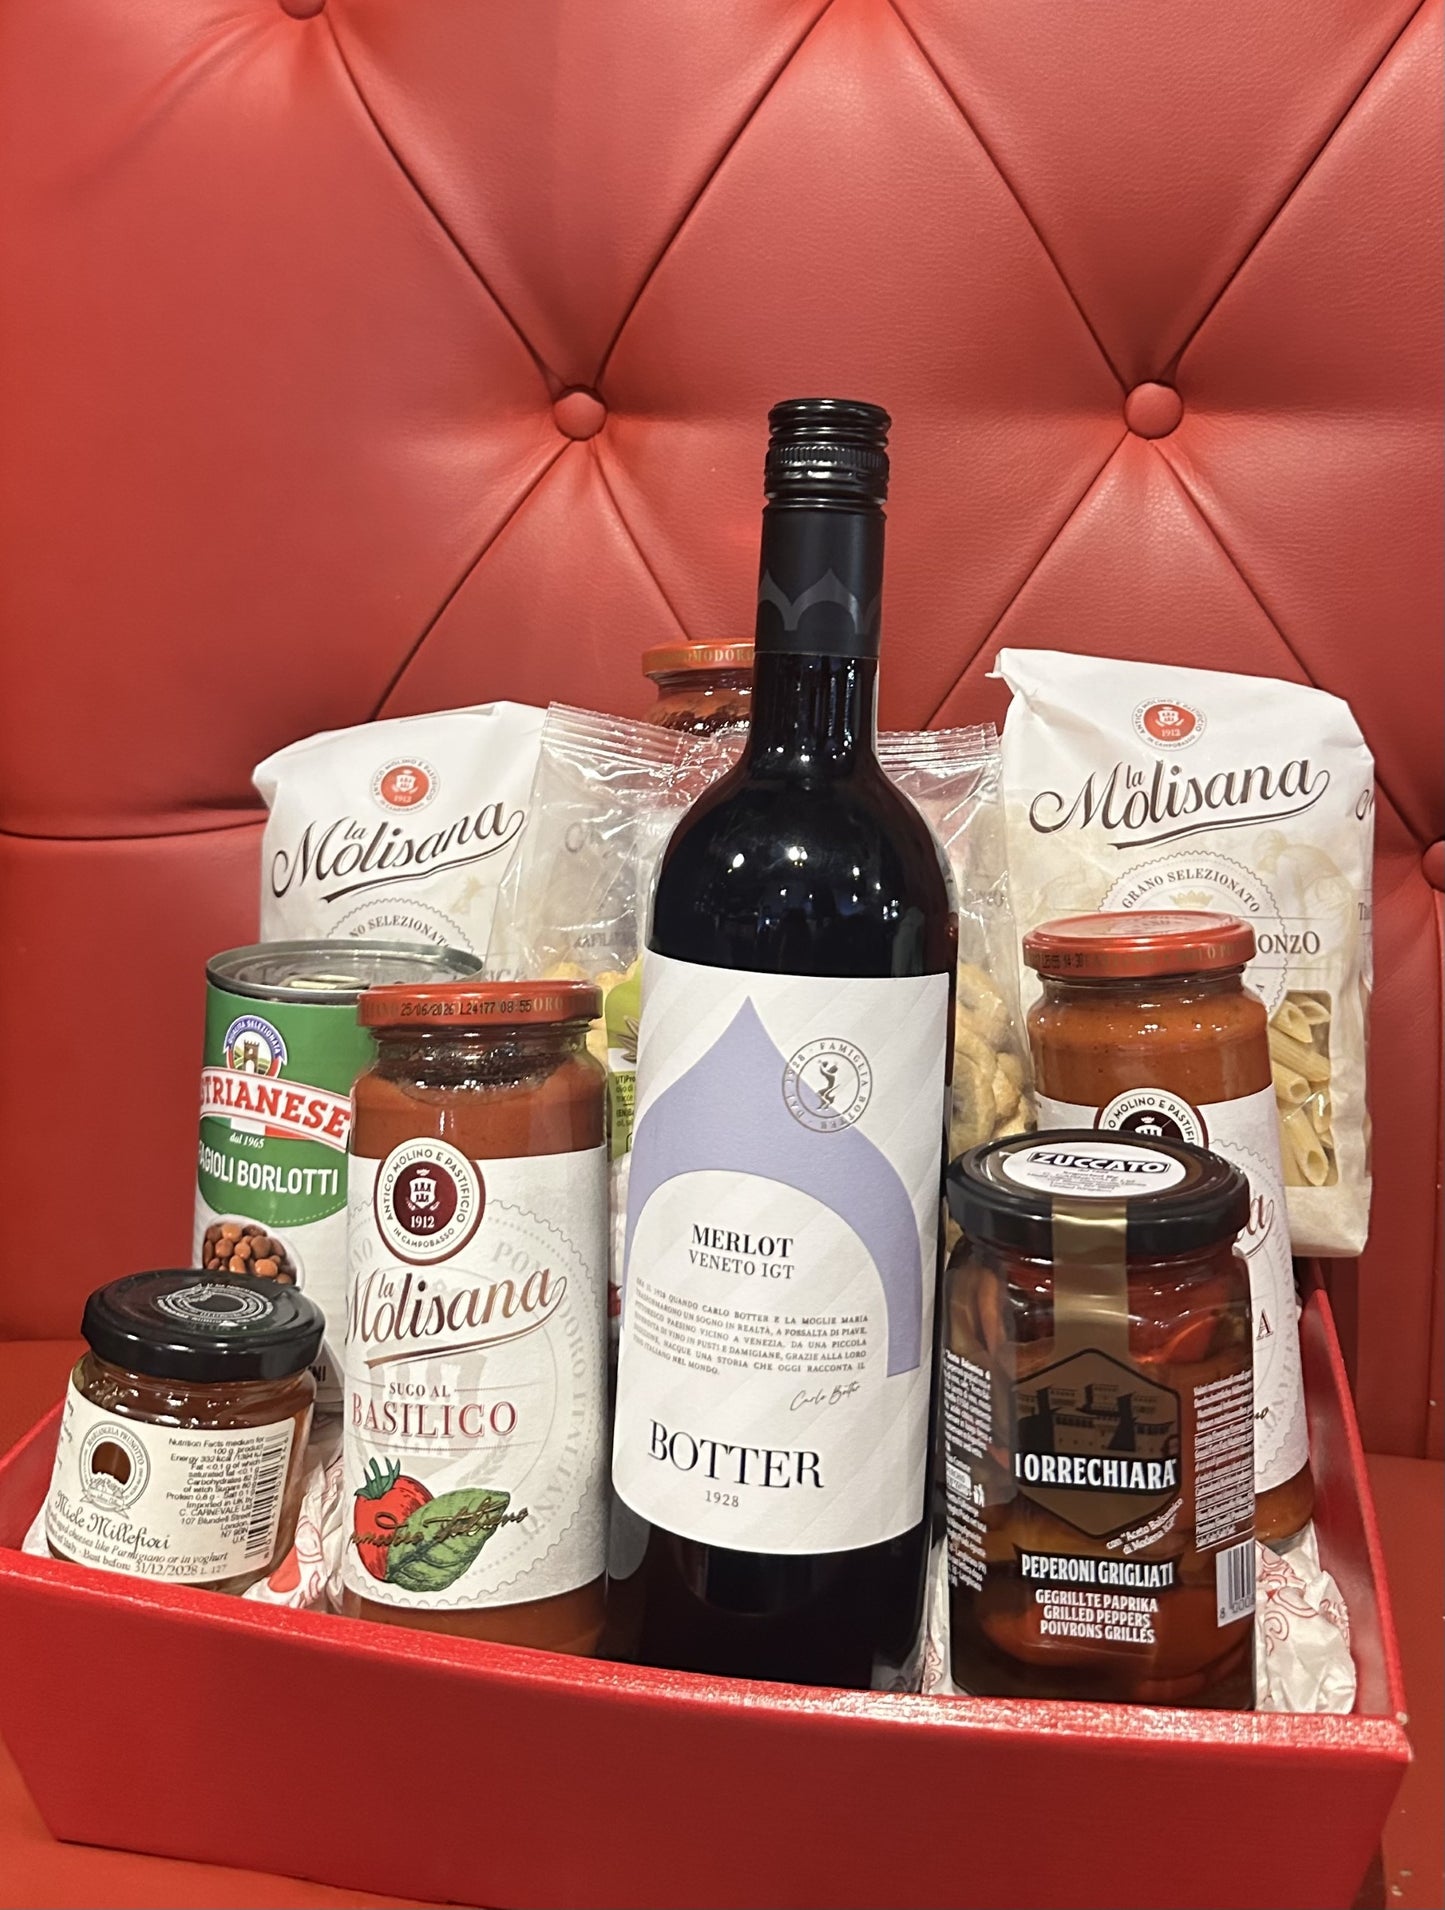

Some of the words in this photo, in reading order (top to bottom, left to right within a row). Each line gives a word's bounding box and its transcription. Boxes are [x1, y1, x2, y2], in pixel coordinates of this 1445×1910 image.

[1161, 728, 1181, 737] 1912
[1126, 764, 1144, 788] la
[1029, 758, 1331, 834] Molisana
[344, 820, 368, 841] la
[271, 801, 526, 898] Molisana
[1121, 876, 1164, 910] GRANO
[1167, 868, 1261, 914] SELEZIONATO
[1257, 930, 1321, 956] ONZO
[460, 1000, 495, 1016] L24177
[500, 999, 532, 1013] 08:55
[819, 1041, 869, 1087] FAMIGLIA
[1113, 1096, 1156, 1120] MOLINO
[1158, 1100, 1166, 1109] E
[1167, 1103, 1196, 1142] PASTIFI
[243, 1133, 265, 1150] 1965
[1033, 1152, 1165, 1173] ZUCCATO
[237, 1160, 338, 1196] BORLOTTI
[384, 1173, 394, 1221] ANTICO
[393, 1148, 433, 1173] MOLINO
[435, 1151, 444, 1162] E
[444, 1157, 470, 1224] PASTIFICIO
[410, 1215, 435, 1229] 1912
[393, 1227, 402, 1238] IN
[401, 1228, 455, 1248] CAMPOBASSO
[691, 1223, 794, 1258] MERLOT
[688, 1249, 755, 1276] VENETO
[762, 1262, 796, 1280] IGT
[377, 1272, 394, 1299] la
[344, 1267, 568, 1347] Molisana
[668, 1293, 699, 1311] QUANDO
[701, 1304, 730, 1317] CARLO
[734, 1310, 769, 1323] BOTTER
[774, 1316, 780, 1324] E
[785, 1316, 797, 1325] LA
[801, 1316, 837, 1325] MOGLIE
[841, 1314, 869, 1324] MARIA
[666, 1317, 697, 1333] PAESINO
[699, 1327, 730, 1341] VICINO
[791, 1341, 803, 1349] DA
[808, 1340, 827, 1349] UNA
[831, 1338, 867, 1348] PICCOLA
[683, 1311, 695, 1321] UN
[695, 1314, 724, 1328] SOGNO
[725, 1321, 735, 1330] IN
[784, 1328, 828, 1337] FOSSALTA
[829, 1328, 840, 1337] DI
[663, 1339, 692, 1356] NACQUE
[695, 1350, 713, 1362] UNA
[716, 1355, 749, 1369] STORIA
[753, 1361, 773, 1371] CHE
[777, 1363, 802, 1373] OGGI
[806, 1363, 853, 1373] RACCONTA
[668, 1328, 686, 1342] VINO
[686, 1336, 696, 1345] IN
[697, 1338, 721, 1352] FUSTI
[785, 1351, 819, 1361] GRAZIE
[820, 1351, 843, 1361] ALLA
[844, 1349, 867, 1360] LORO
[672, 1354, 686, 1366] NEL
[388, 1380, 426, 1398] SUGO
[429, 1384, 451, 1398] AL
[351, 1391, 519, 1440] BASILICO
[168, 1438, 202, 1448] Nutrition
[203, 1440, 224, 1448] Facts
[225, 1438, 254, 1447] medium
[214, 1447, 227, 1455] 100
[648, 1418, 825, 1489] BOTTER
[170, 1453, 199, 1465] Energy
[216, 1453, 232, 1462] kcal
[190, 1463, 203, 1471] Fat
[232, 1461, 240, 1469] of
[187, 1477, 242, 1488] Carbohydrates
[166, 1492, 194, 1500] Protein
[186, 1499, 222, 1511] Imported
[704, 1489, 740, 1508] 1928
[181, 1517, 196, 1525] 107
[231, 1511, 251, 1521] Street
[190, 1506, 239, 1516] CARNEVALE
[1105, 1537, 1123, 1550] con
[1147, 1497, 1184, 1531] Balsamico
[87, 1512, 171, 1553] Millefiori
[221, 1530, 232, 1538] N7
[1123, 1543, 1135, 1555] di
[1131, 1529, 1165, 1551] Modena
[83, 1548, 101, 1563] Best
[134, 1561, 198, 1577] 31/12/2028
[210, 1565, 228, 1575] 127
[95, 1539, 111, 1553] like
[111, 1545, 165, 1565] Parmigiano
[167, 1555, 179, 1564] or
[180, 1552, 190, 1564] in
[191, 1551, 229, 1566] yoghurt
[1021, 1553, 1095, 1583] PEPERONI
[1098, 1561, 1174, 1588] GRIGLIATI
[1035, 1588, 1101, 1608] GEGRILLTE
[1103, 1594, 1159, 1613] PAPRIKA
[1043, 1604, 1095, 1623] GRILLED
[1096, 1609, 1151, 1628] PEPPERS
[1040, 1619, 1103, 1639] POIVRONS
[1104, 1623, 1156, 1644] GRILLÉS
